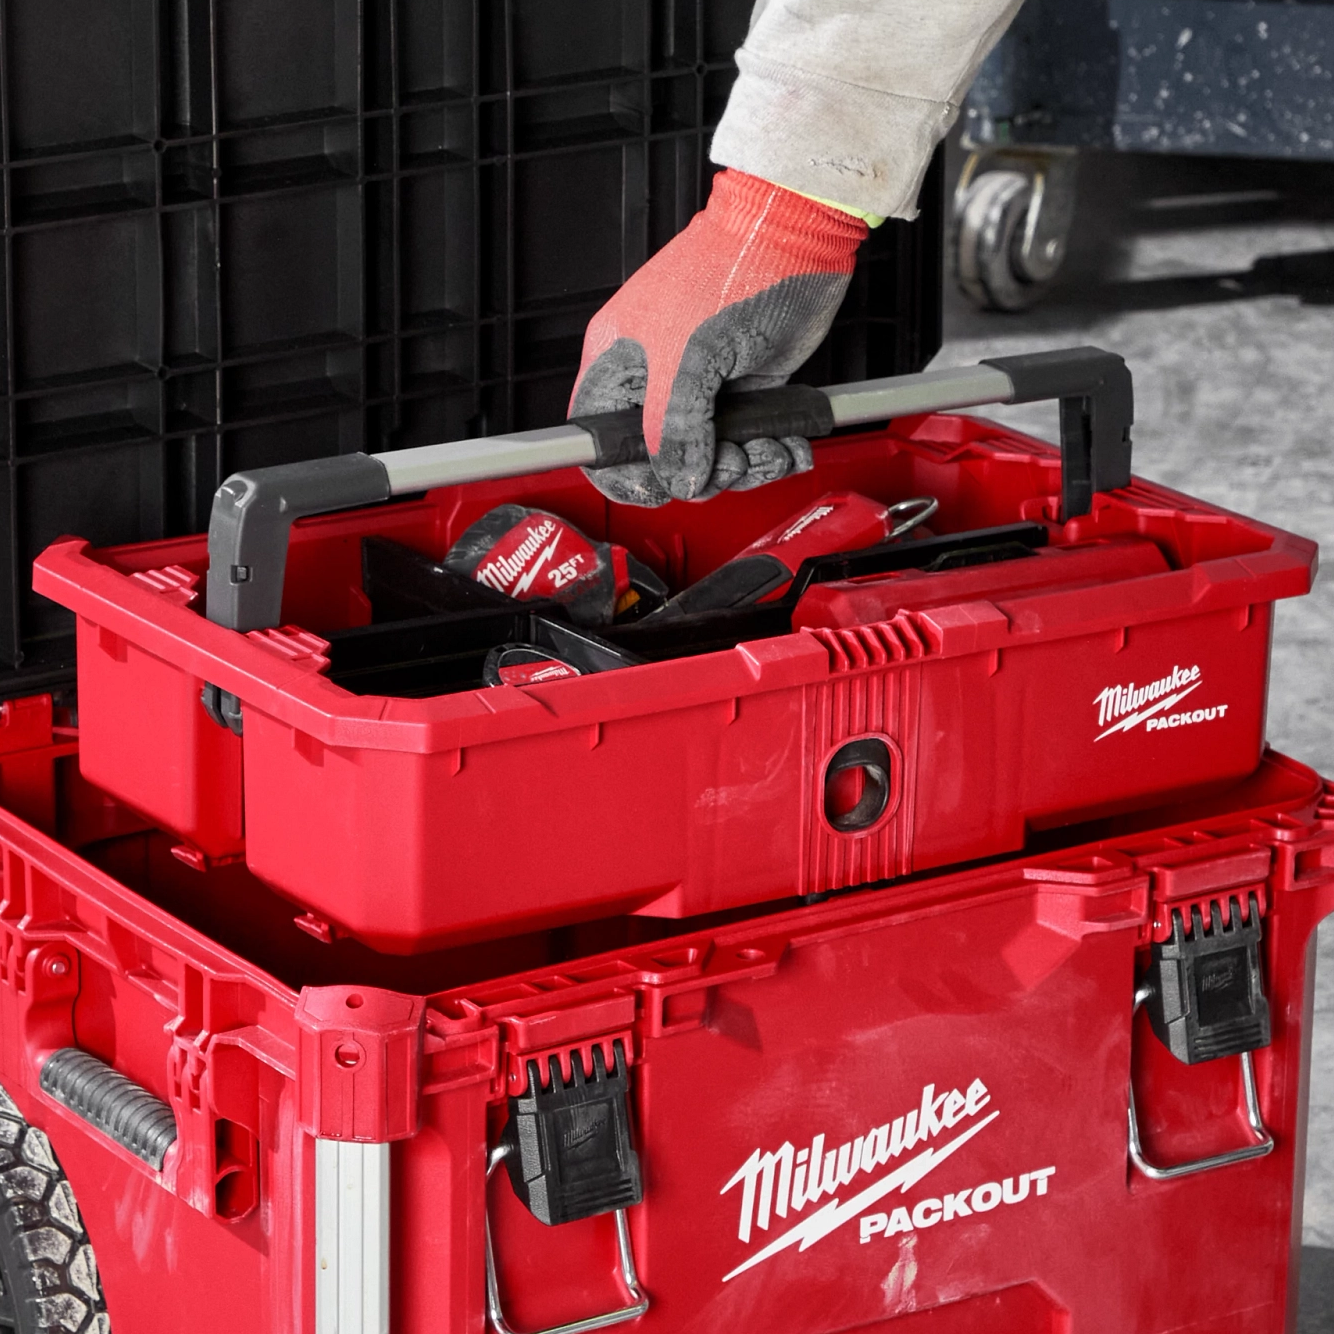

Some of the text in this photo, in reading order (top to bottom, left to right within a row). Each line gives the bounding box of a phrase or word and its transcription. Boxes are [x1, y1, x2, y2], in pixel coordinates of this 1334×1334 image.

[477, 519, 556, 593] Milwaukee
[1093, 665, 1201, 727] Milwaukee
[1146, 705, 1228, 732] PACKOUT
[720, 1078, 991, 1244] Milwaukee
[860, 1166, 1056, 1244] PACKOUT
